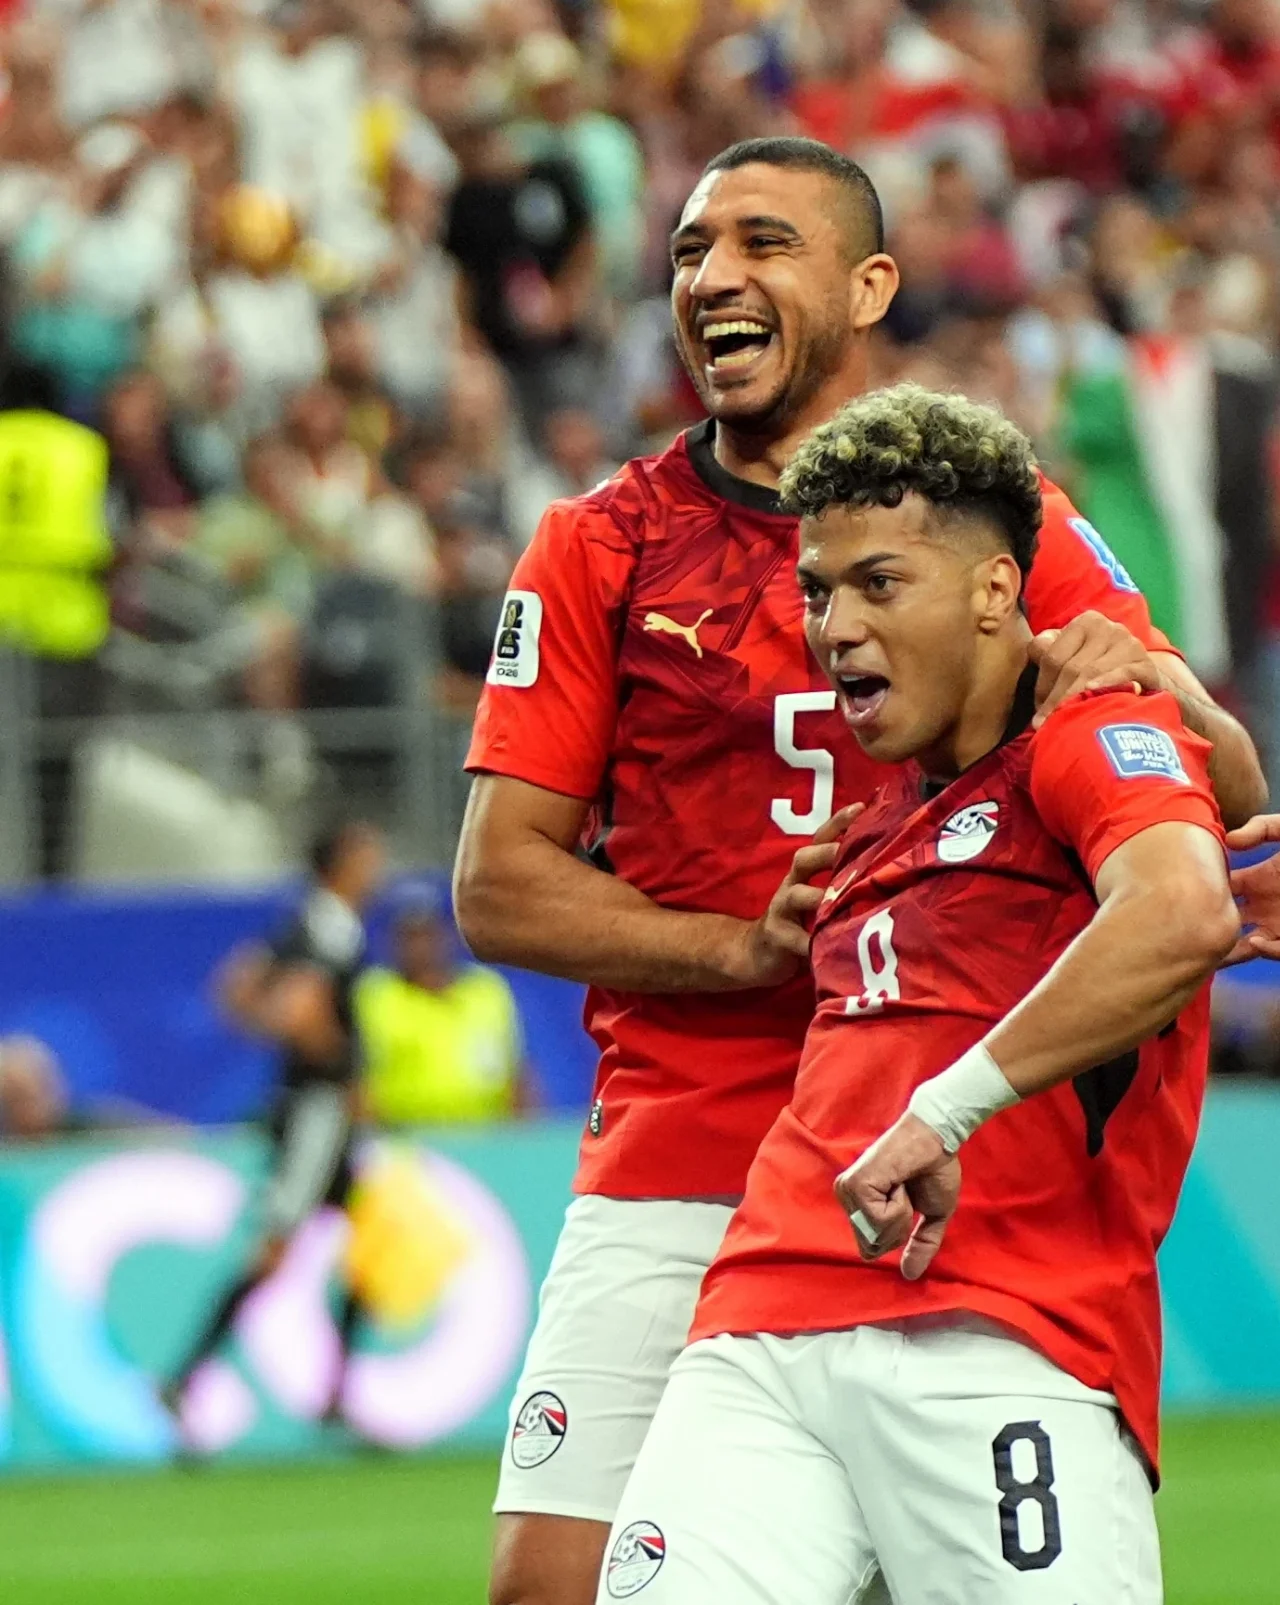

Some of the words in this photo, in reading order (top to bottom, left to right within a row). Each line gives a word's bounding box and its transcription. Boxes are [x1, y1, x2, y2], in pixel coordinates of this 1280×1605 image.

[496, 667, 519, 678] 026
[770, 690, 837, 835] 5
[992, 1420, 1062, 1571] 8
